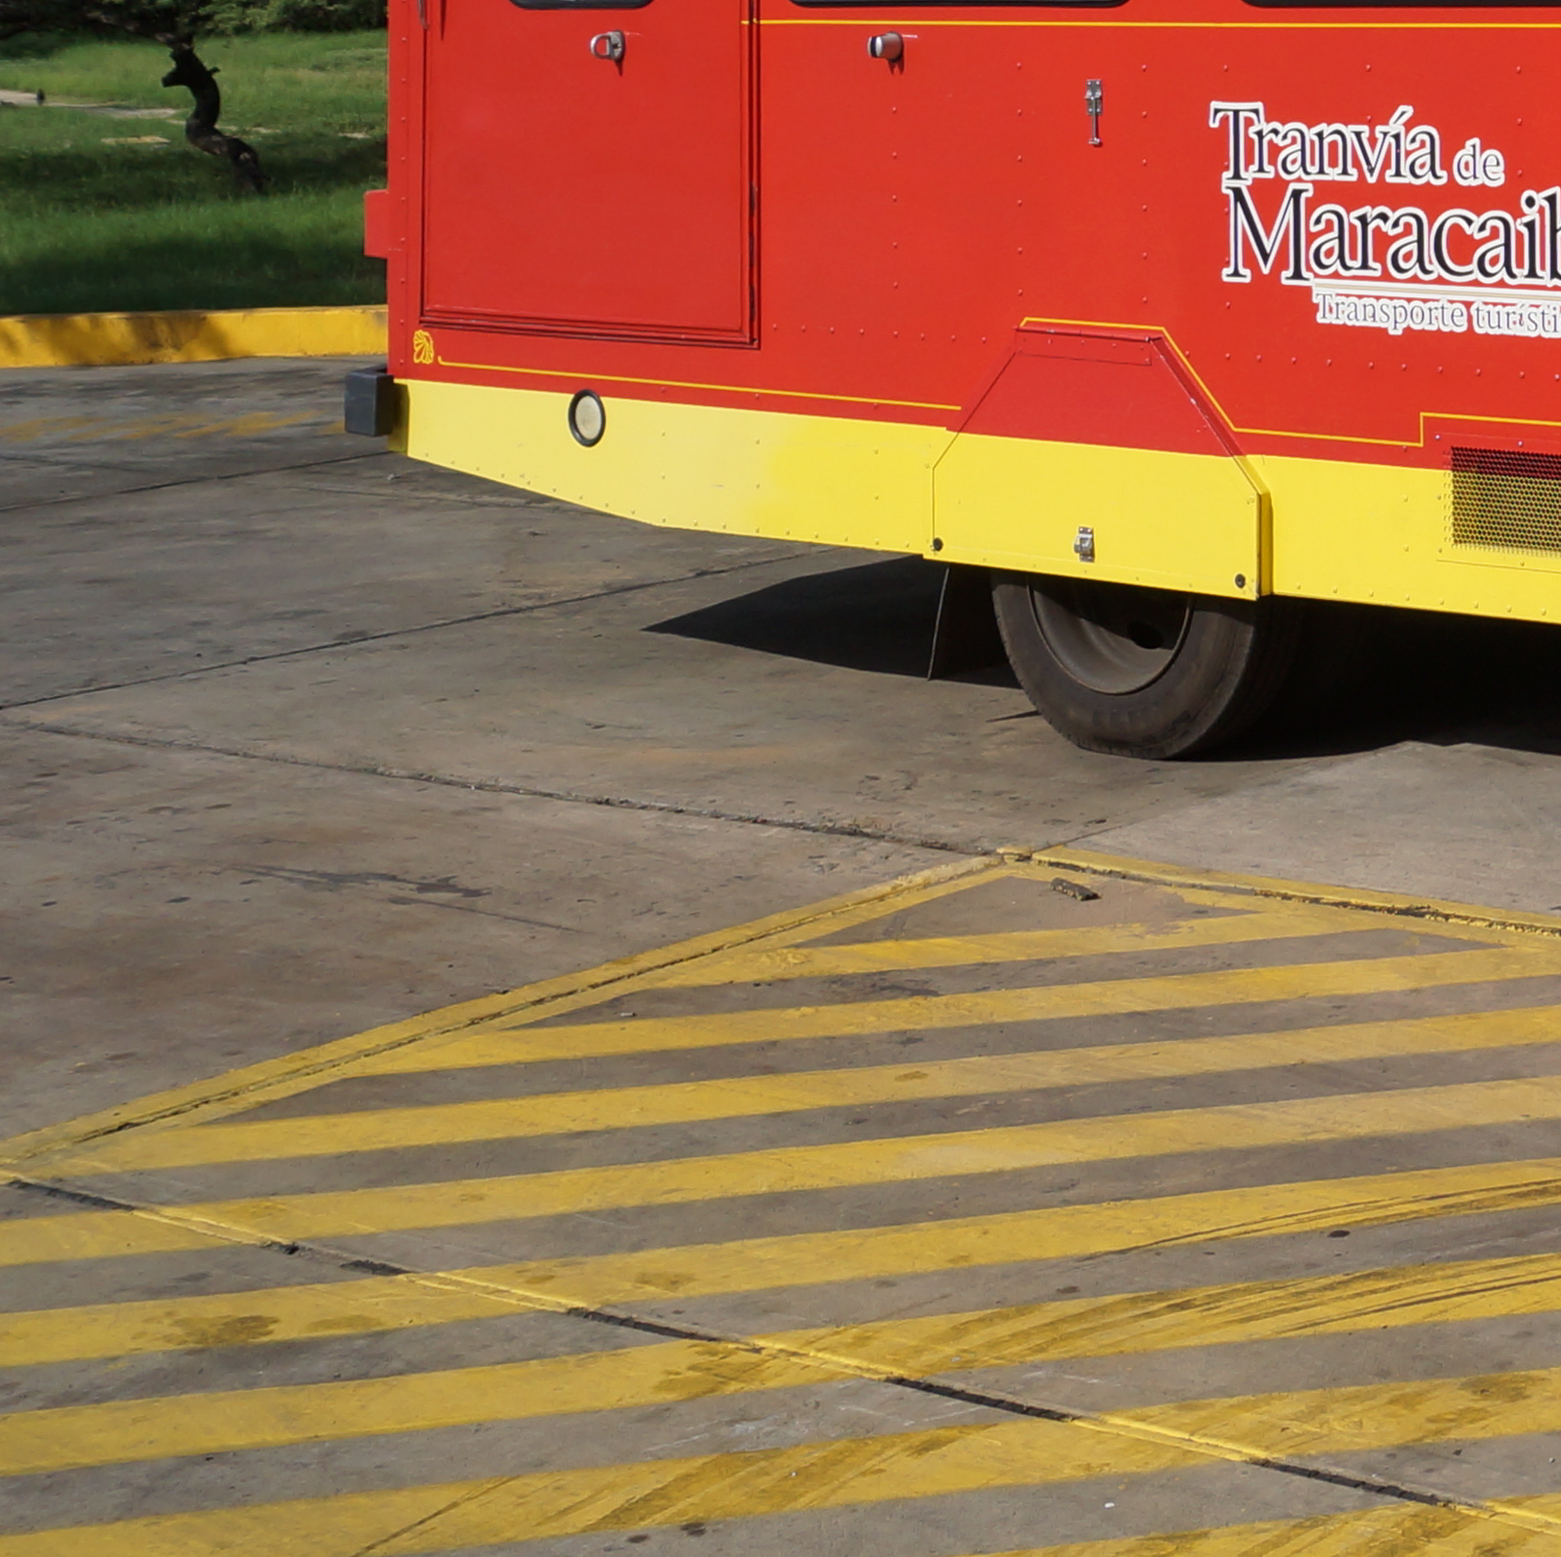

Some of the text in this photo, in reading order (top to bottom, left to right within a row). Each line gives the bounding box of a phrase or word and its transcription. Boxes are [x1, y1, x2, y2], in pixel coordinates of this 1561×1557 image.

[1209, 104, 1502, 182] Tranvía de
[1315, 292, 1466, 330] Transporte
